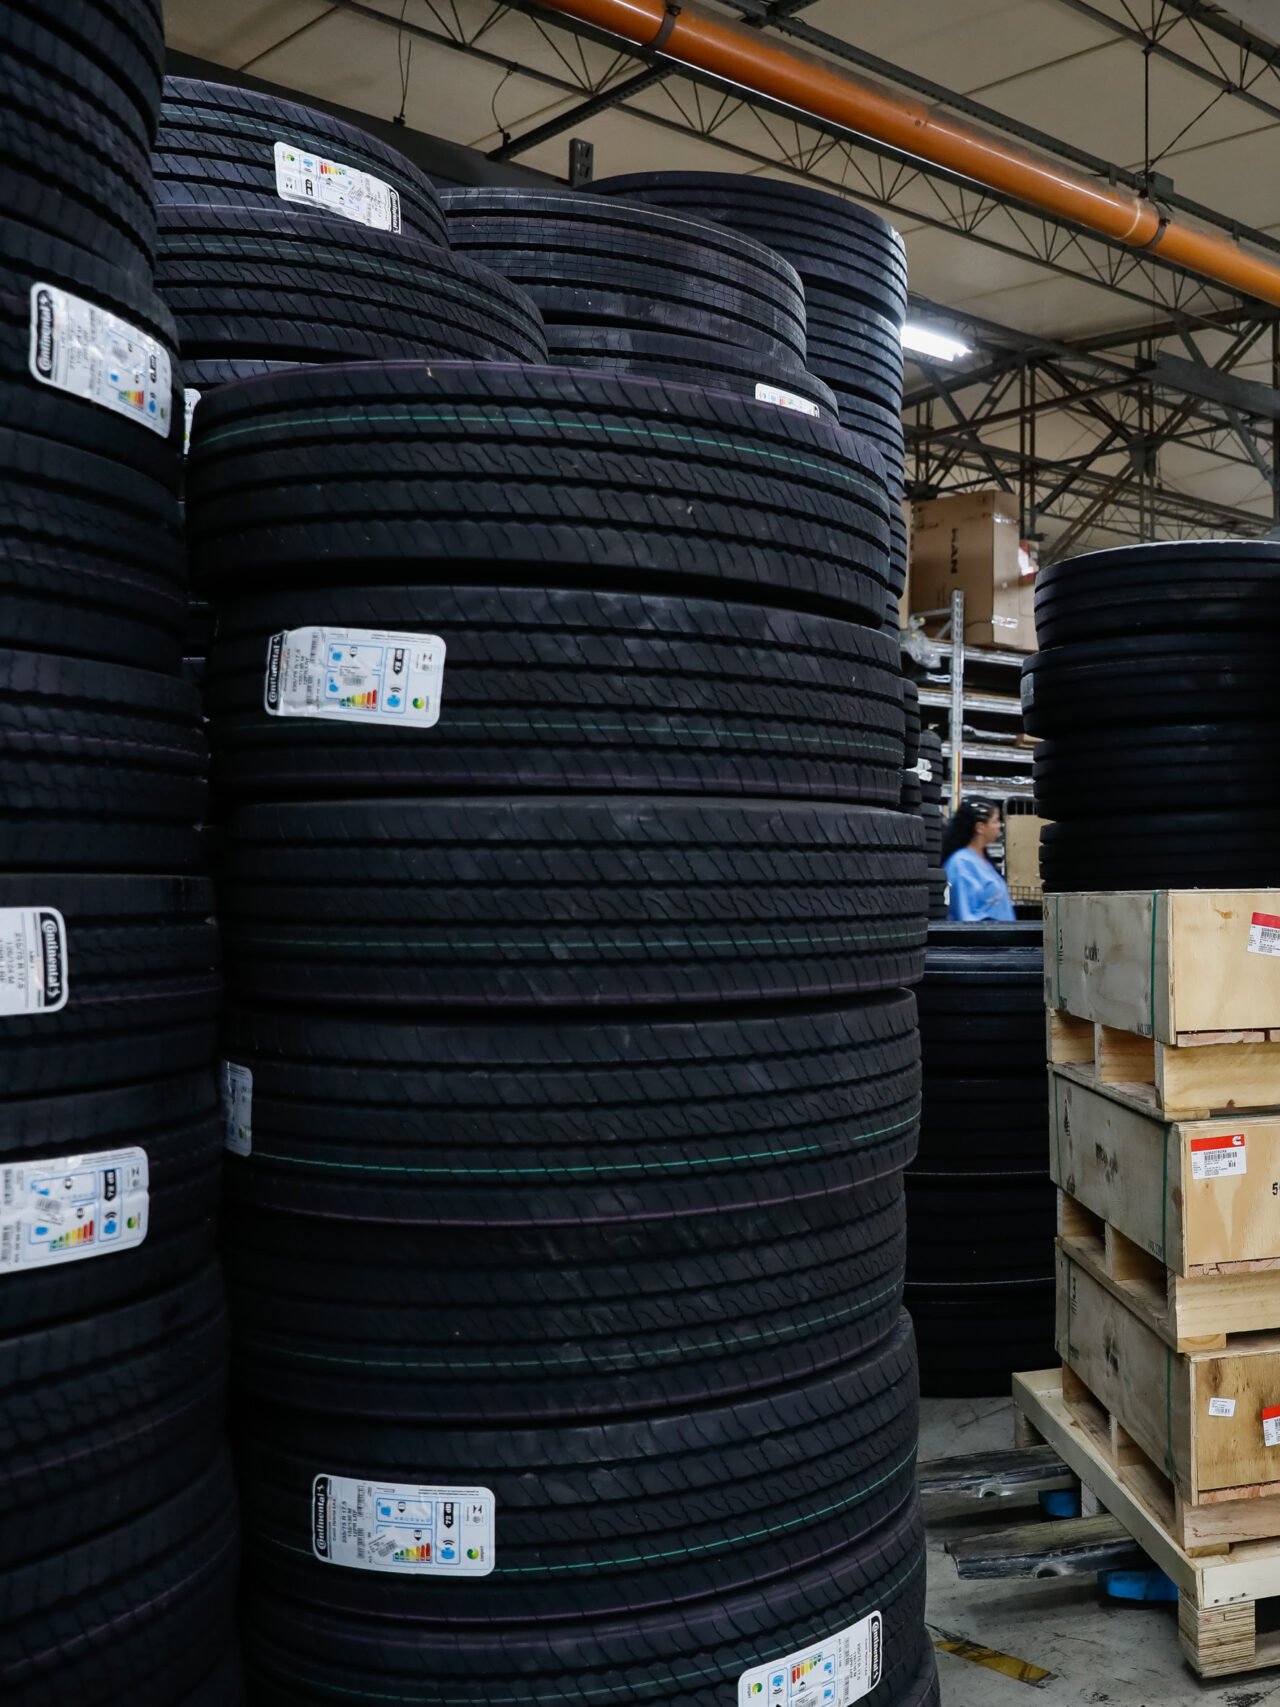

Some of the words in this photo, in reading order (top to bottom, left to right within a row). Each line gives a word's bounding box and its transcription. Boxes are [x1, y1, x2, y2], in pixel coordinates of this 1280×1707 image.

[37, 305, 53, 371] Continental
[42, 919, 60, 987] Continental
[316, 1493, 327, 1550] Continental
[444, 1503, 452, 1514] dB
[445, 1515, 452, 1525] 72
[871, 1620, 880, 1671] Continental
